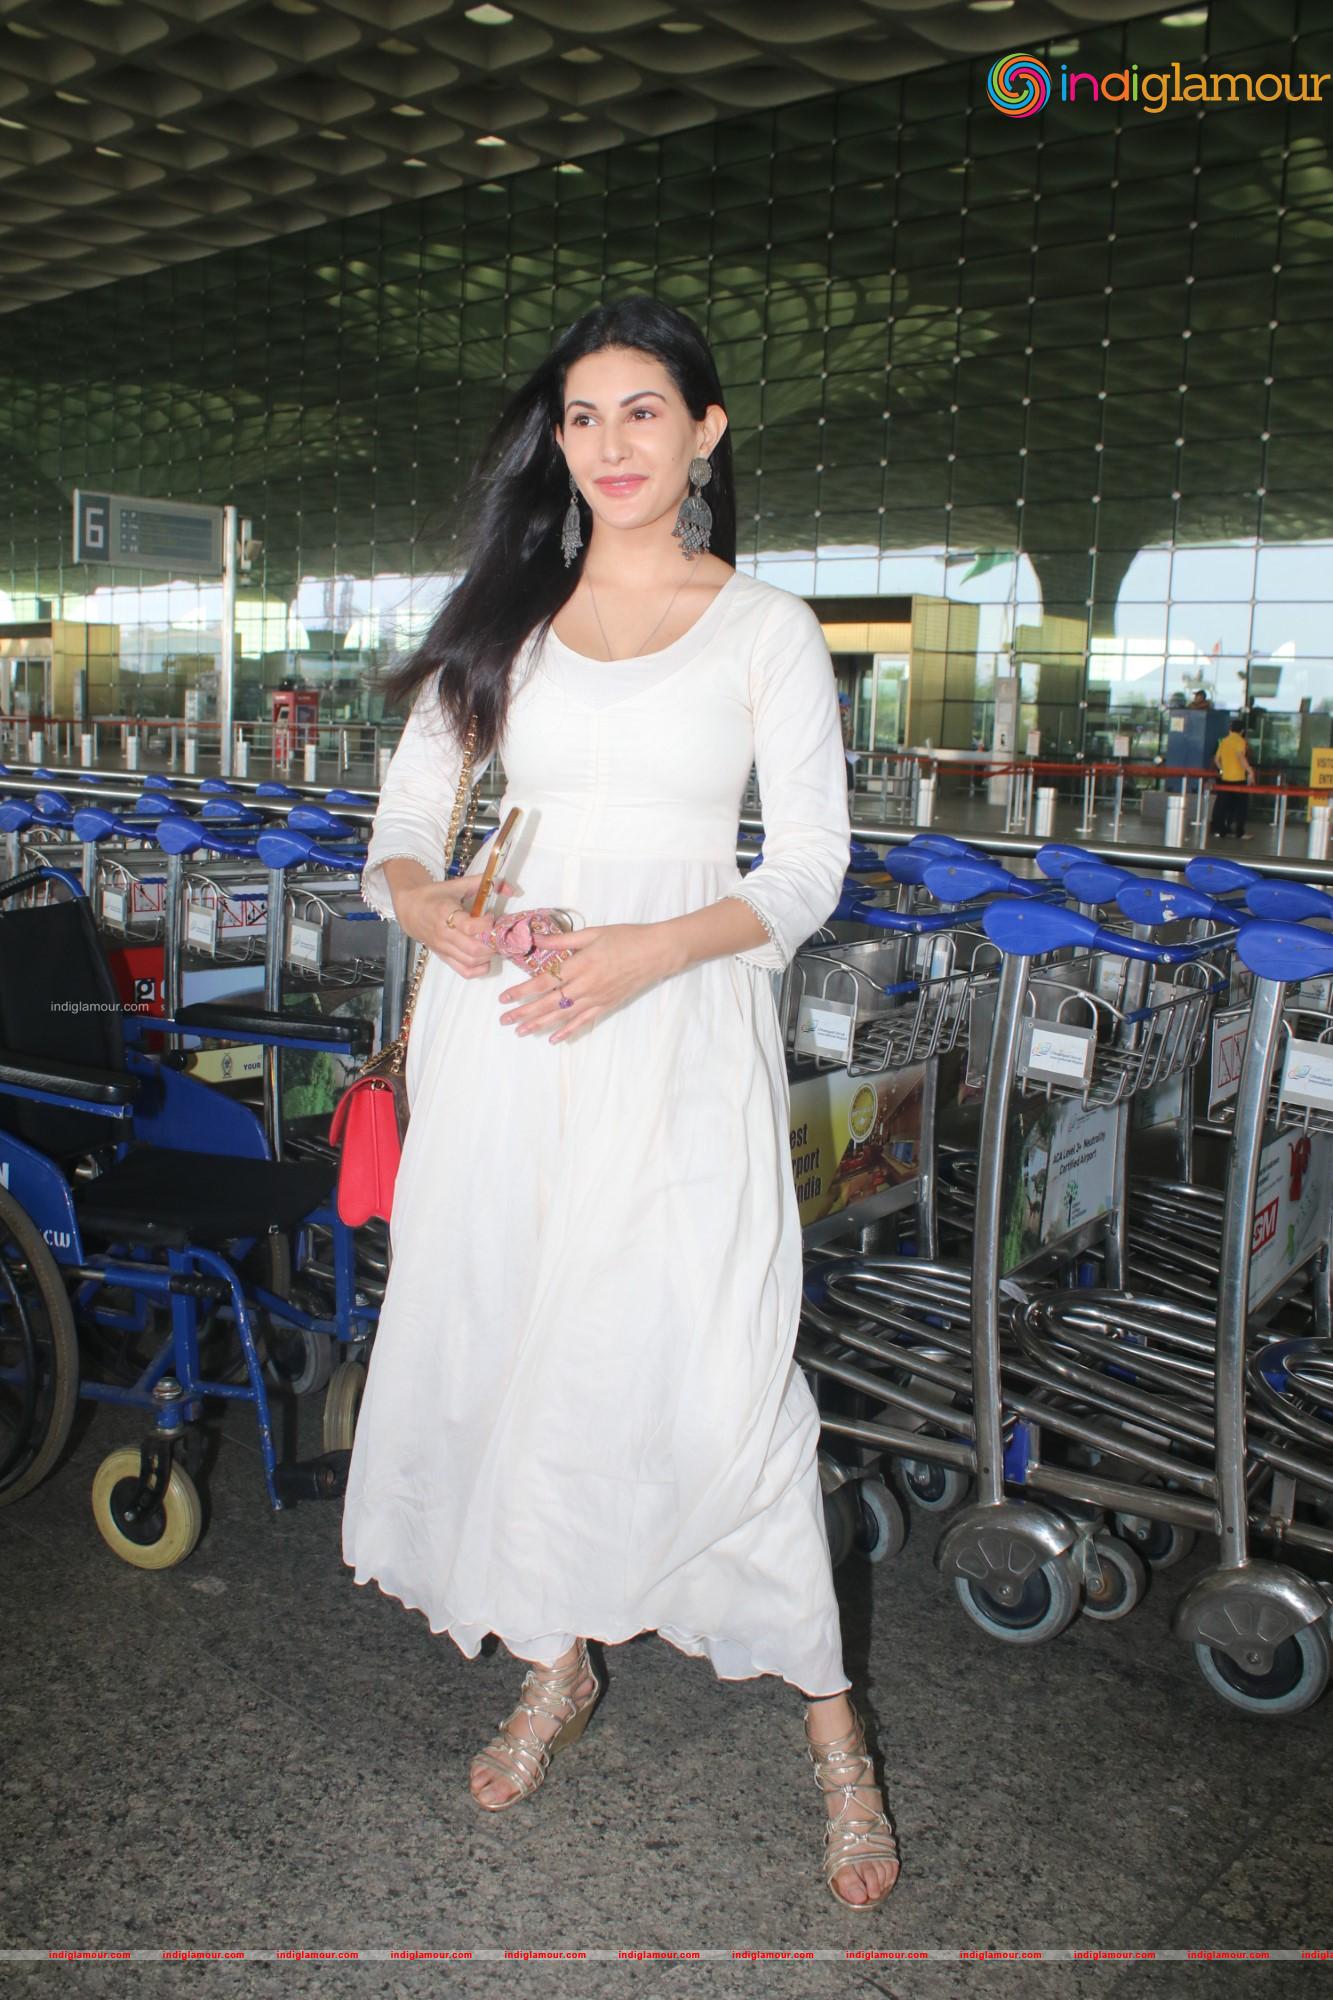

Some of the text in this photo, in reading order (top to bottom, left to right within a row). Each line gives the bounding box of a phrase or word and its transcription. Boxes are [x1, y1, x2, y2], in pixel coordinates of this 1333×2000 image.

[86, 507, 104, 548] 6
[789, 1123, 808, 1149] est
[792, 1148, 820, 1178] rport
[1059, 1149, 1097, 1175] Certified Airport
[1063, 1145, 1076, 1160] Level
[795, 1176, 822, 1203] ndia
[43, 1229, 71, 1249] CW
